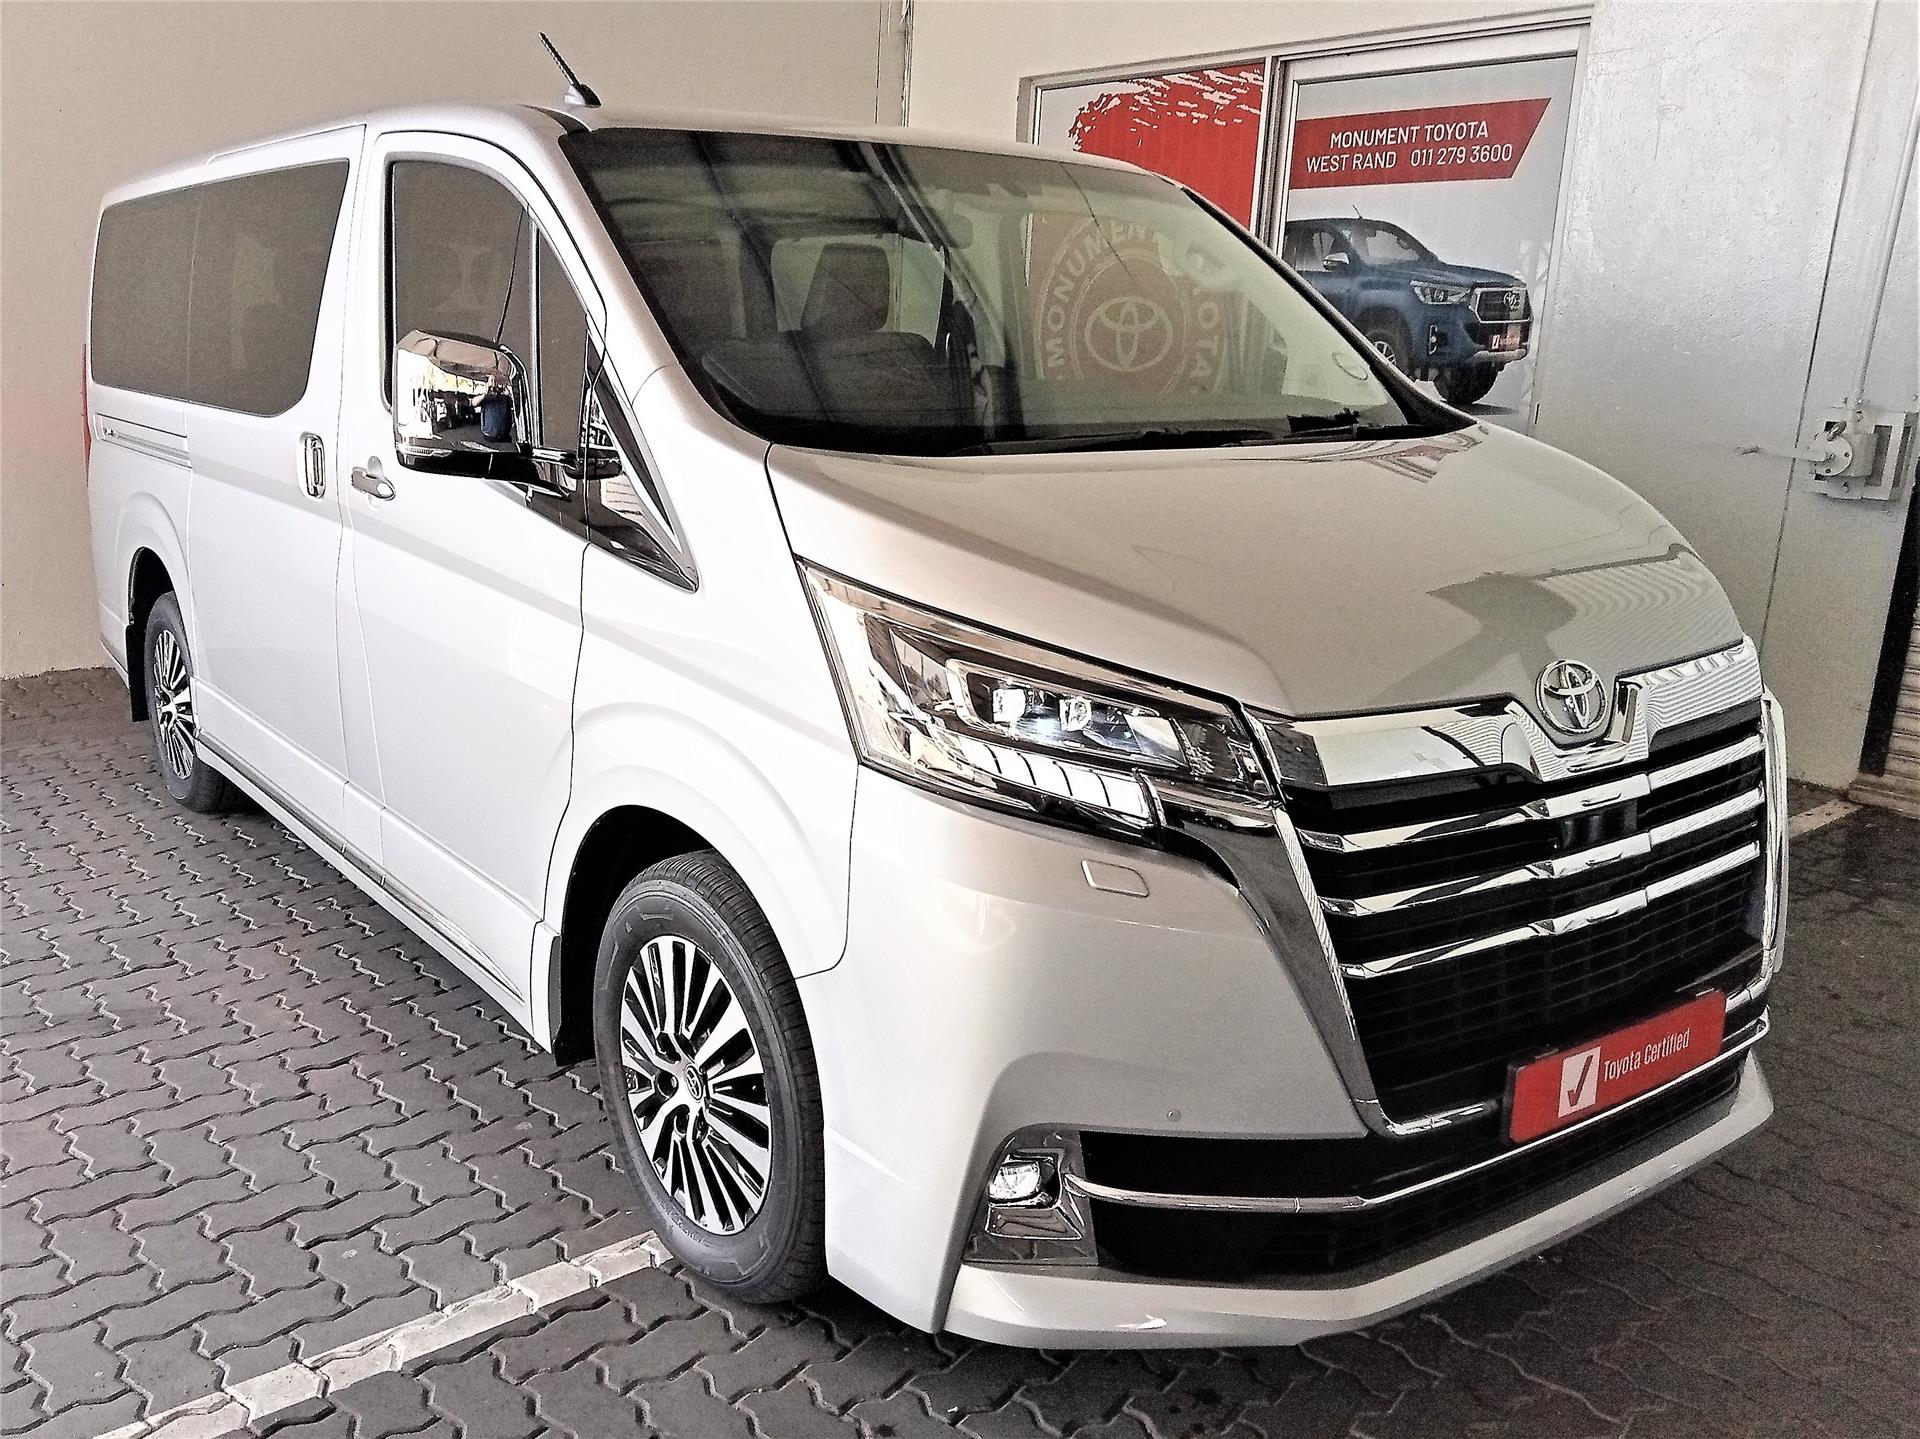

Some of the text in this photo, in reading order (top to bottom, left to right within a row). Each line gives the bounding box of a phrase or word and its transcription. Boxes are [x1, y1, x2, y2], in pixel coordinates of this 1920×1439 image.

[1330, 121, 1488, 149] MONUMENT TOYOTA
[1306, 143, 1512, 173] WEST RAND 011 279 3600
[1045, 221, 1148, 368] MONUMEN
[1604, 1028, 1691, 1082] Toyota Certified
